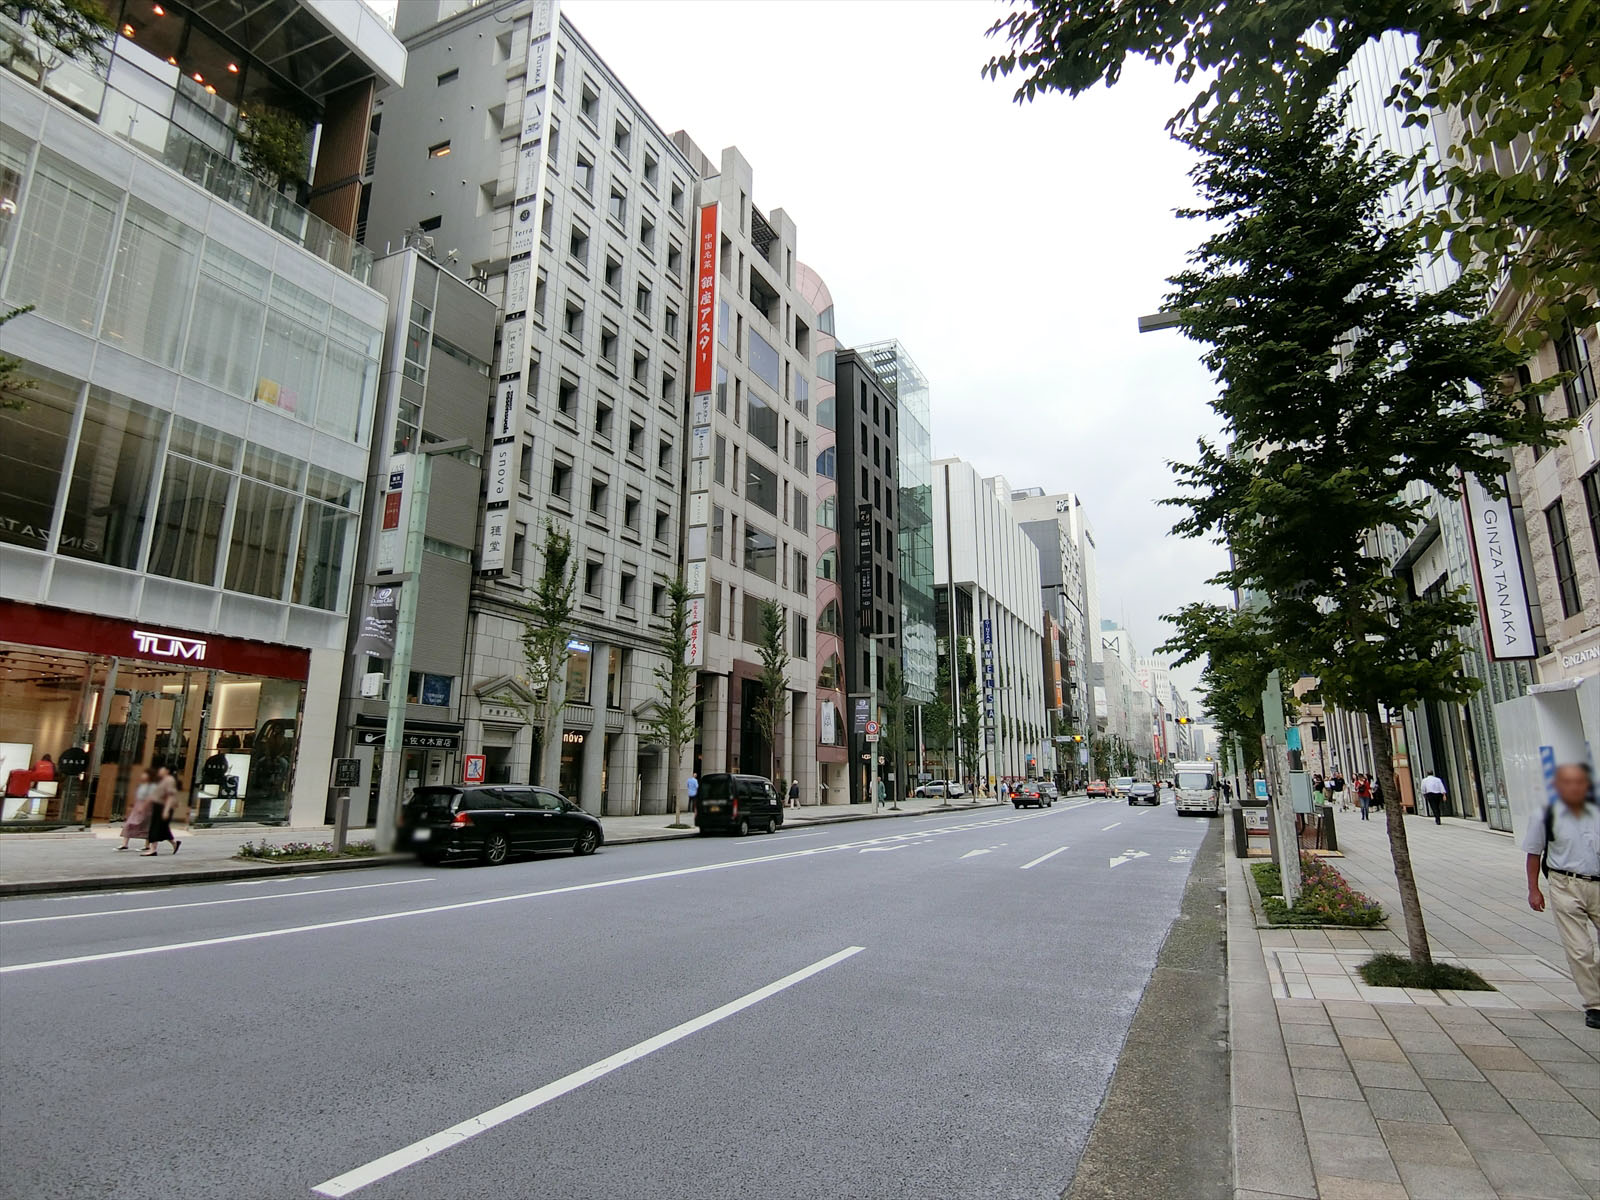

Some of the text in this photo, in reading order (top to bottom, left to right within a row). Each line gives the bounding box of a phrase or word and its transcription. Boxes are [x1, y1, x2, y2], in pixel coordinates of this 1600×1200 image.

[534, 55, 543, 84] YUTAKA
[514, 228, 533, 238] Terra
[703, 233, 713, 269] 中国名菜
[699, 276, 713, 364] 銀座アスター
[133, 630, 207, 661] TUMI
[985, 650, 994, 718] MELSA
[410, 736, 452, 748] 佐々木商店
[62, 757, 86, 766] SALE
[208, 762, 225, 770] SALE
